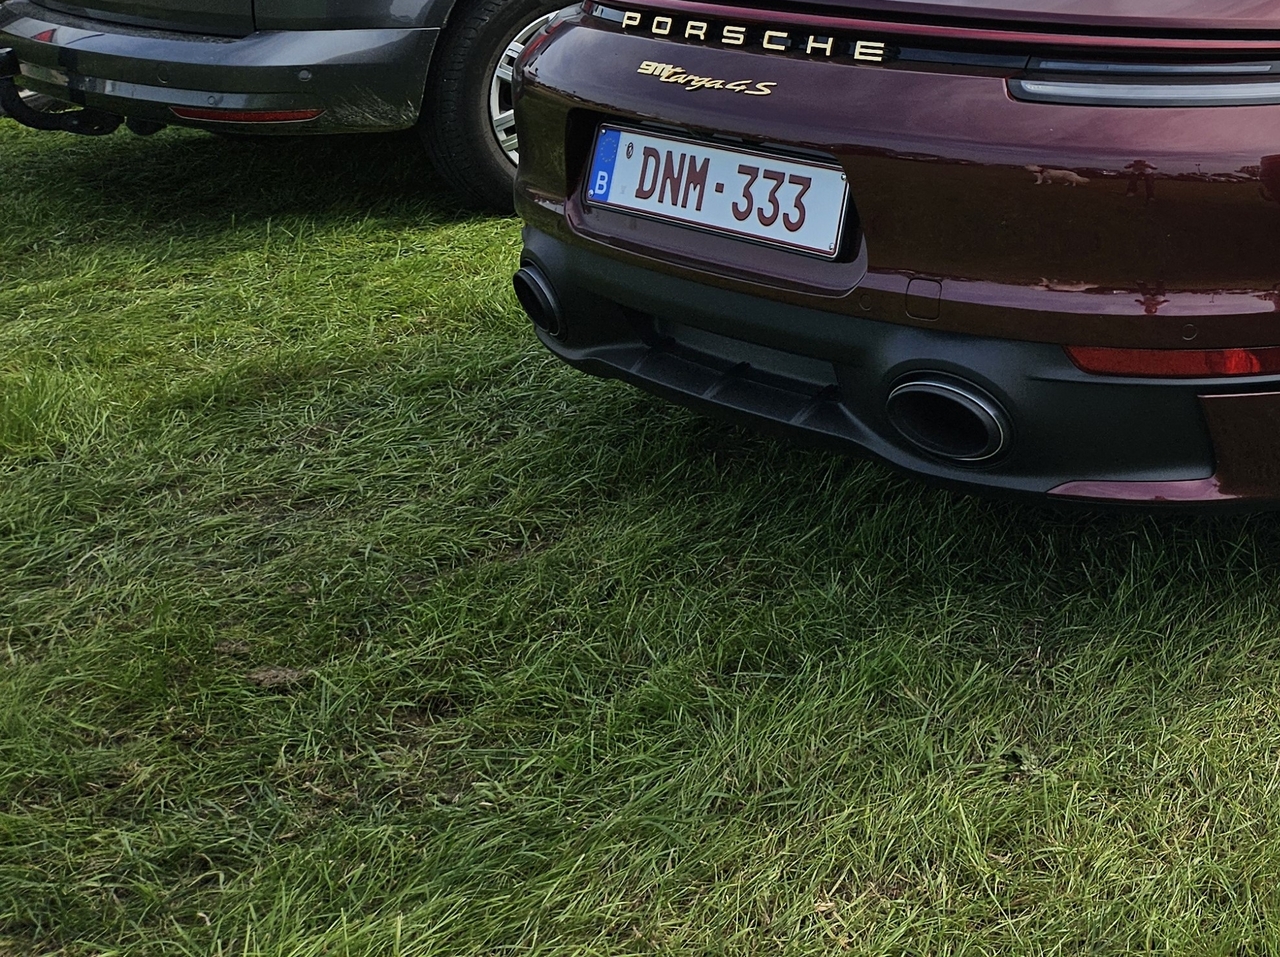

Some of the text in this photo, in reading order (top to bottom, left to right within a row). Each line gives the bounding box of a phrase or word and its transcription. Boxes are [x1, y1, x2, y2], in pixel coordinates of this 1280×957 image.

[621, 10, 885, 62] PORSCHE
[594, 170, 609, 195] B
[634, 146, 812, 232] DNM-333
